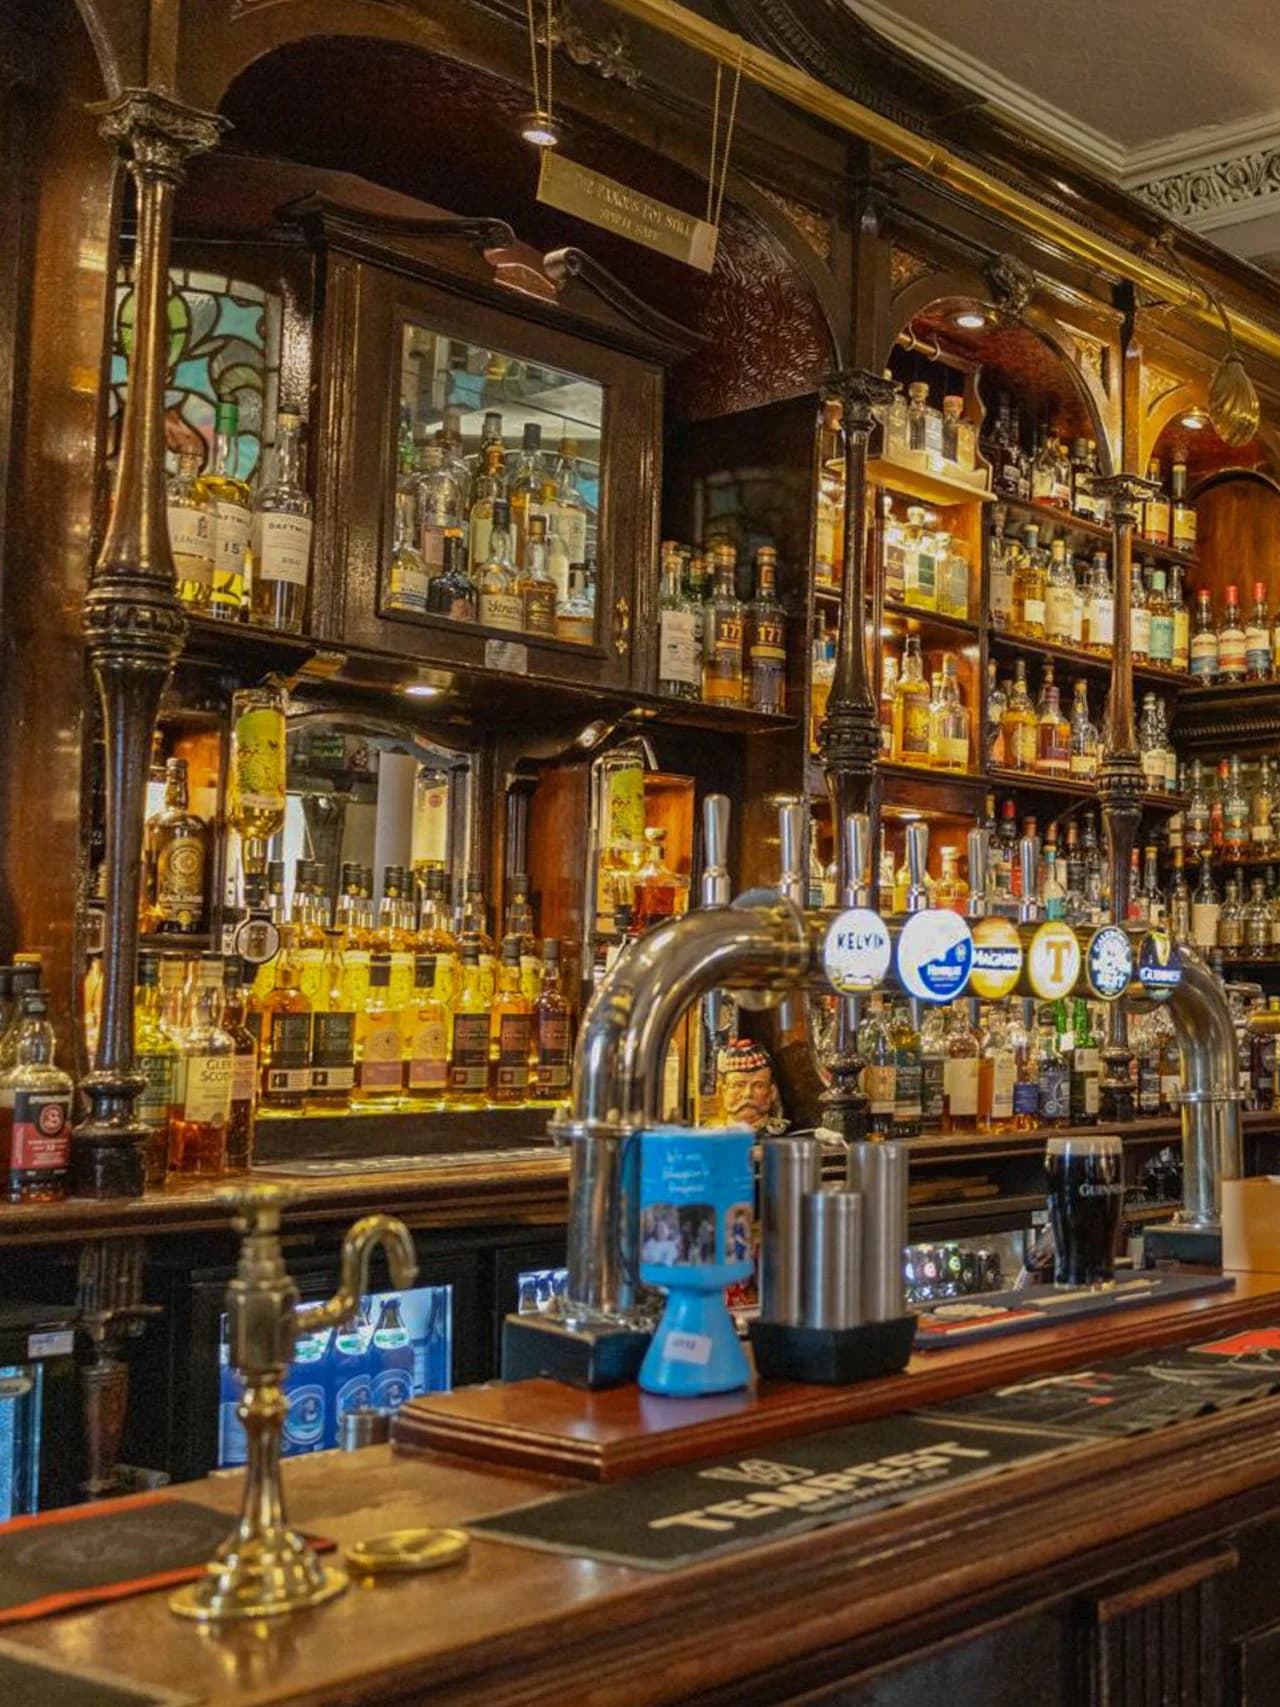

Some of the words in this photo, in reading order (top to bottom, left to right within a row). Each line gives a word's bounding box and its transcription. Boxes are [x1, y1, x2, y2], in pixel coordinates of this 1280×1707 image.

[837, 931, 885, 950] KELVIN
[1045, 940, 1073, 983] T
[649, 1441, 990, 1531] TEMPEST
